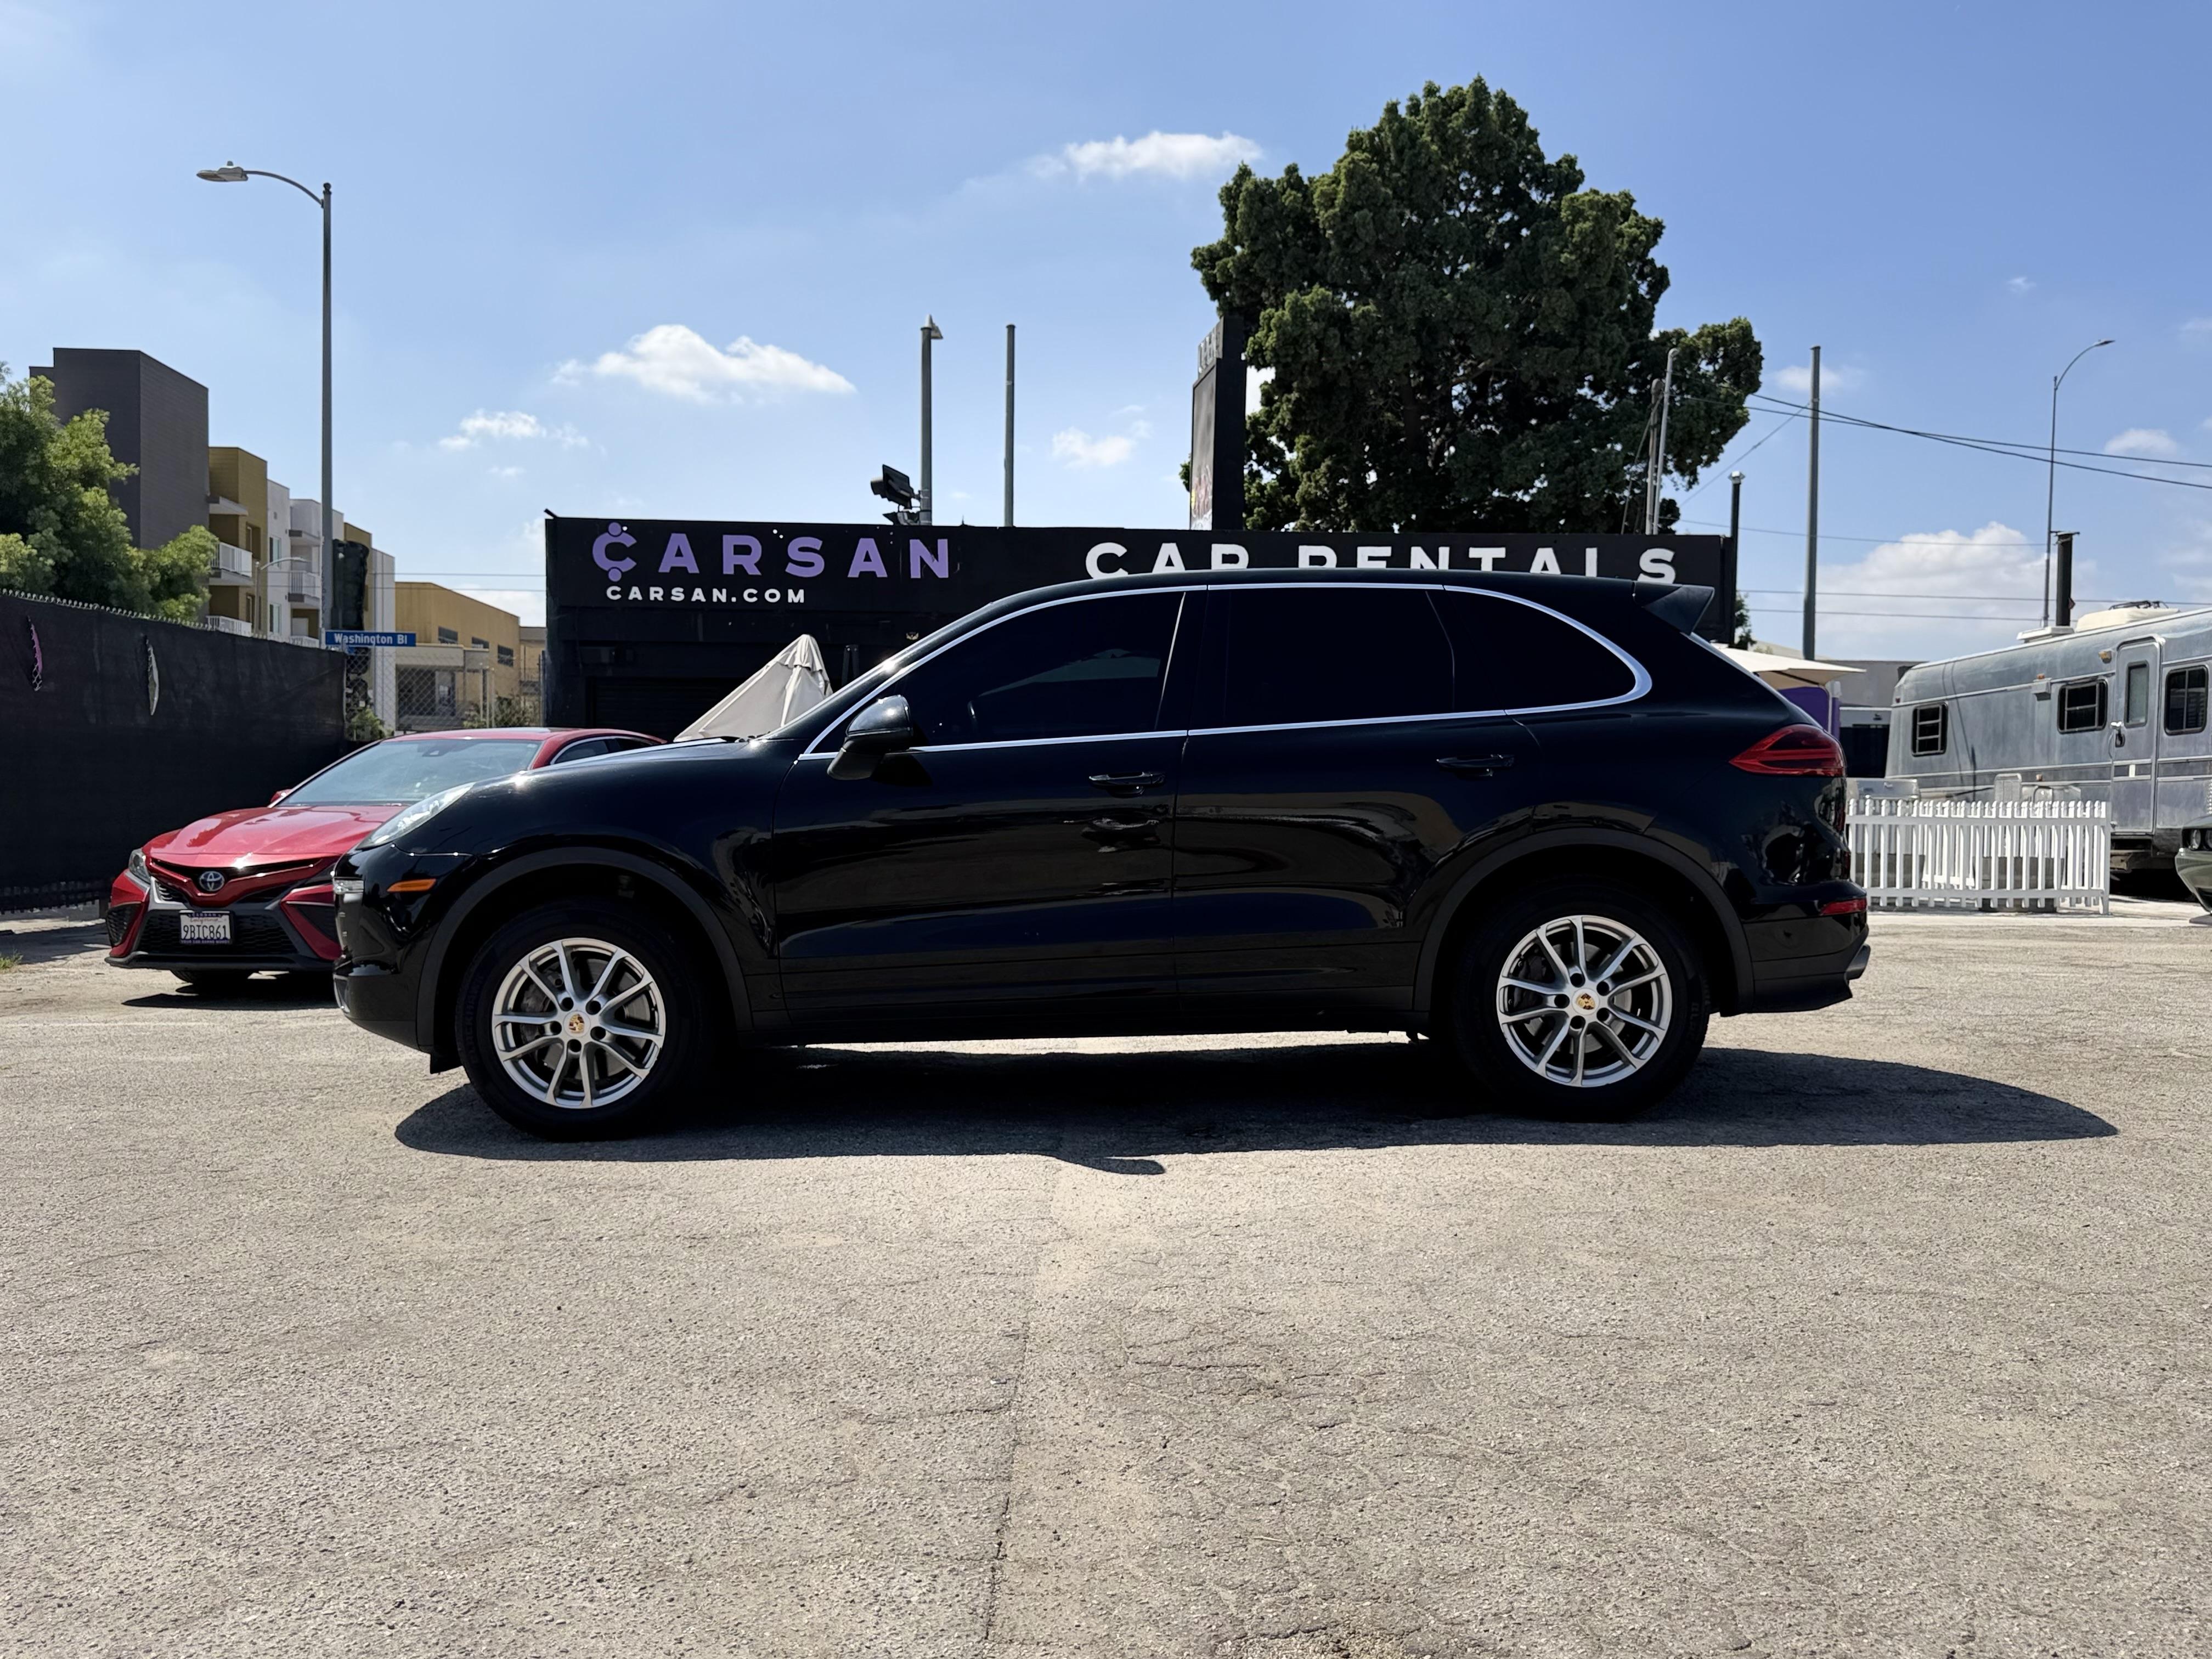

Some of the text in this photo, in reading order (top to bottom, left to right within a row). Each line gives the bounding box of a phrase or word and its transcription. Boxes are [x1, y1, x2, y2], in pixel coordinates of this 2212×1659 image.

[592, 522, 950, 582] CARSAN
[1085, 541, 1249, 579] CAR
[606, 585, 805, 603] CARSAN.COM
[334, 633, 408, 646] Washington Bl
[183, 924, 227, 940] 9BIC861
